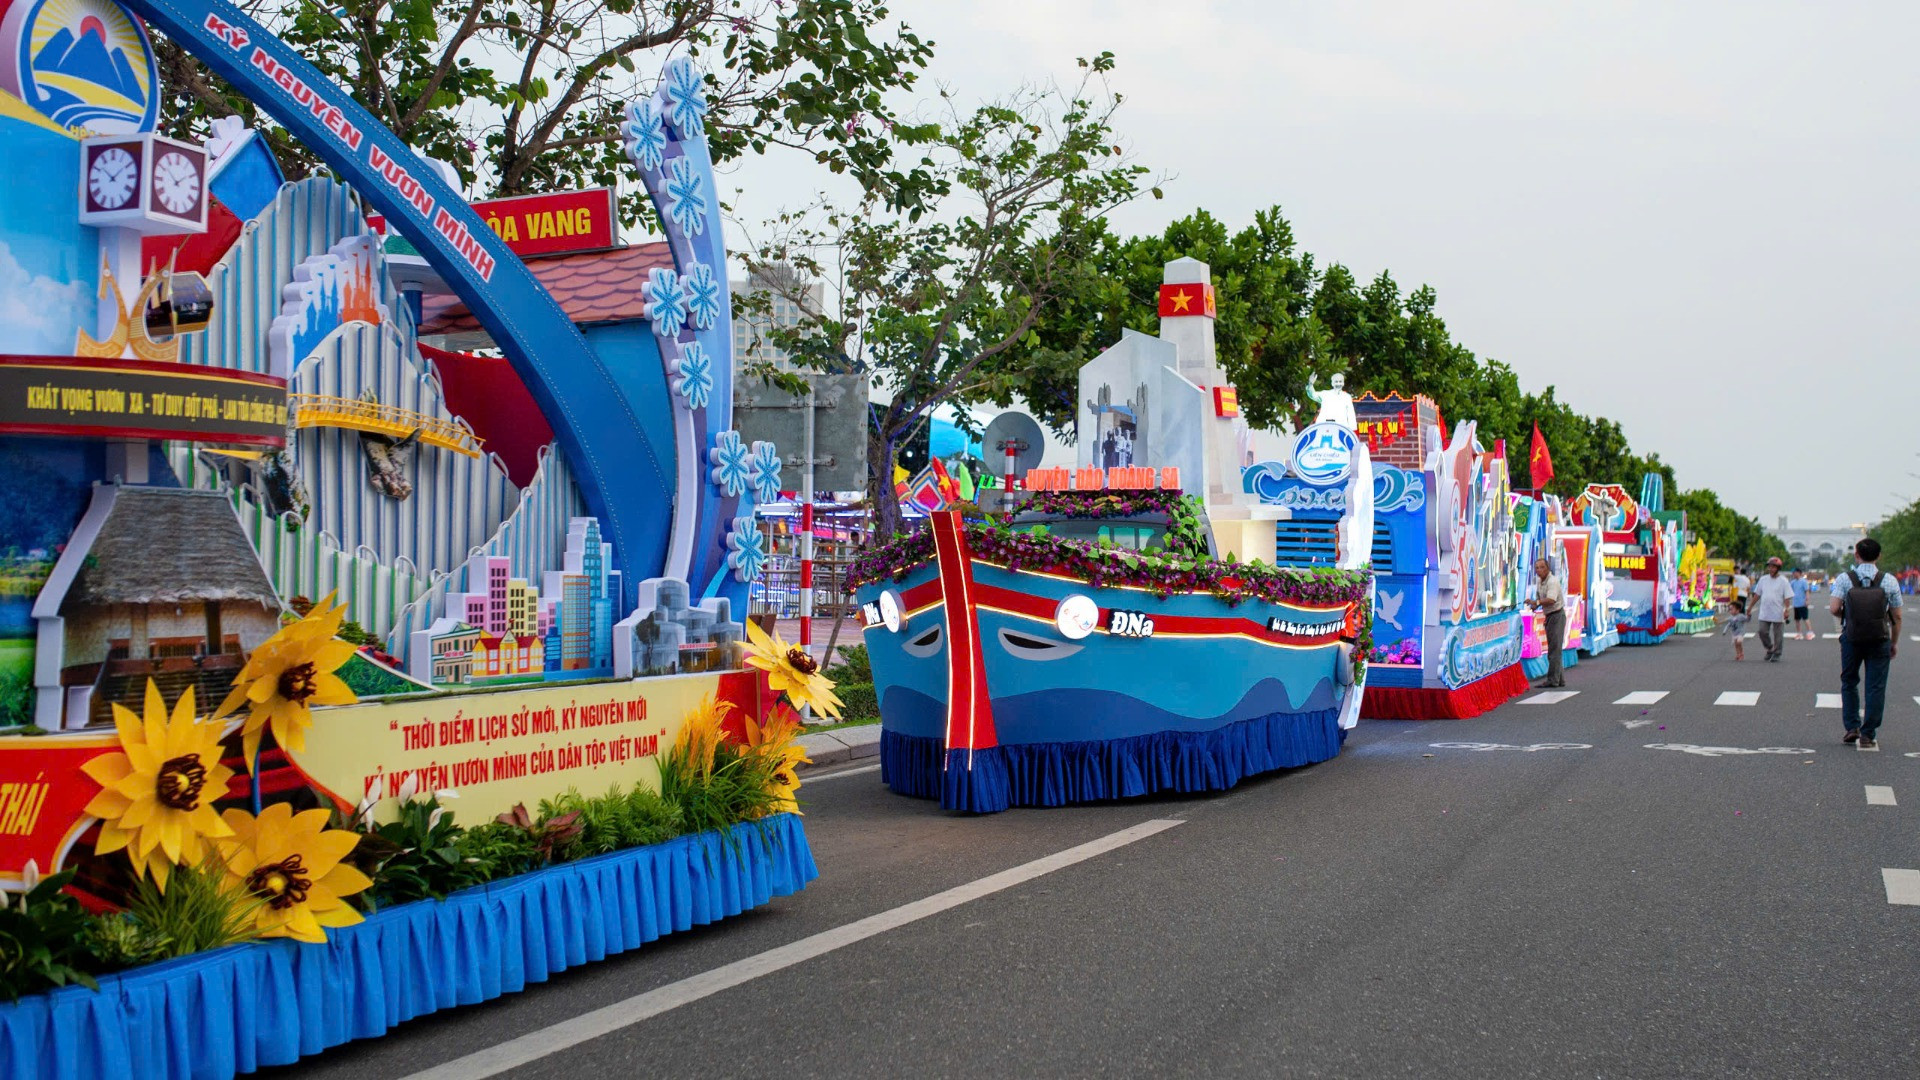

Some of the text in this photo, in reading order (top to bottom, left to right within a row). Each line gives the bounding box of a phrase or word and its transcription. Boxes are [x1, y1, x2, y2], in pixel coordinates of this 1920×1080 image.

[206, 13, 495, 282] KỶ NGUYÊN VƯƠN MÌNH
[525, 208, 591, 240] VANG
[27, 382, 60, 410] KHÁT
[61, 387, 93, 415] VỌNG
[129, 392, 144, 414] XA
[1026, 466, 1070, 495] HUYỆN
[1108, 463, 1156, 490] HOÀNG
[1160, 466, 1180, 490] SA
[1110, 611, 1154, 637] ĐNa
[440, 709, 474, 747] ĐIỂM
[479, 716, 507, 746] LỊCH
[511, 704, 528, 737] SỬ
[532, 701, 559, 735] MỚI,
[562, 699, 577, 731] KỶ
[580, 699, 624, 728] NGUYÊN
[627, 694, 647, 722] MỚI
[452, 756, 489, 787] VƯƠN
[493, 752, 527, 782] MÌNH
[530, 738, 555, 774] CỦA
[558, 742, 582, 770] DÂN
[585, 739, 606, 771] TỘC
[609, 737, 631, 765] VIỆT
